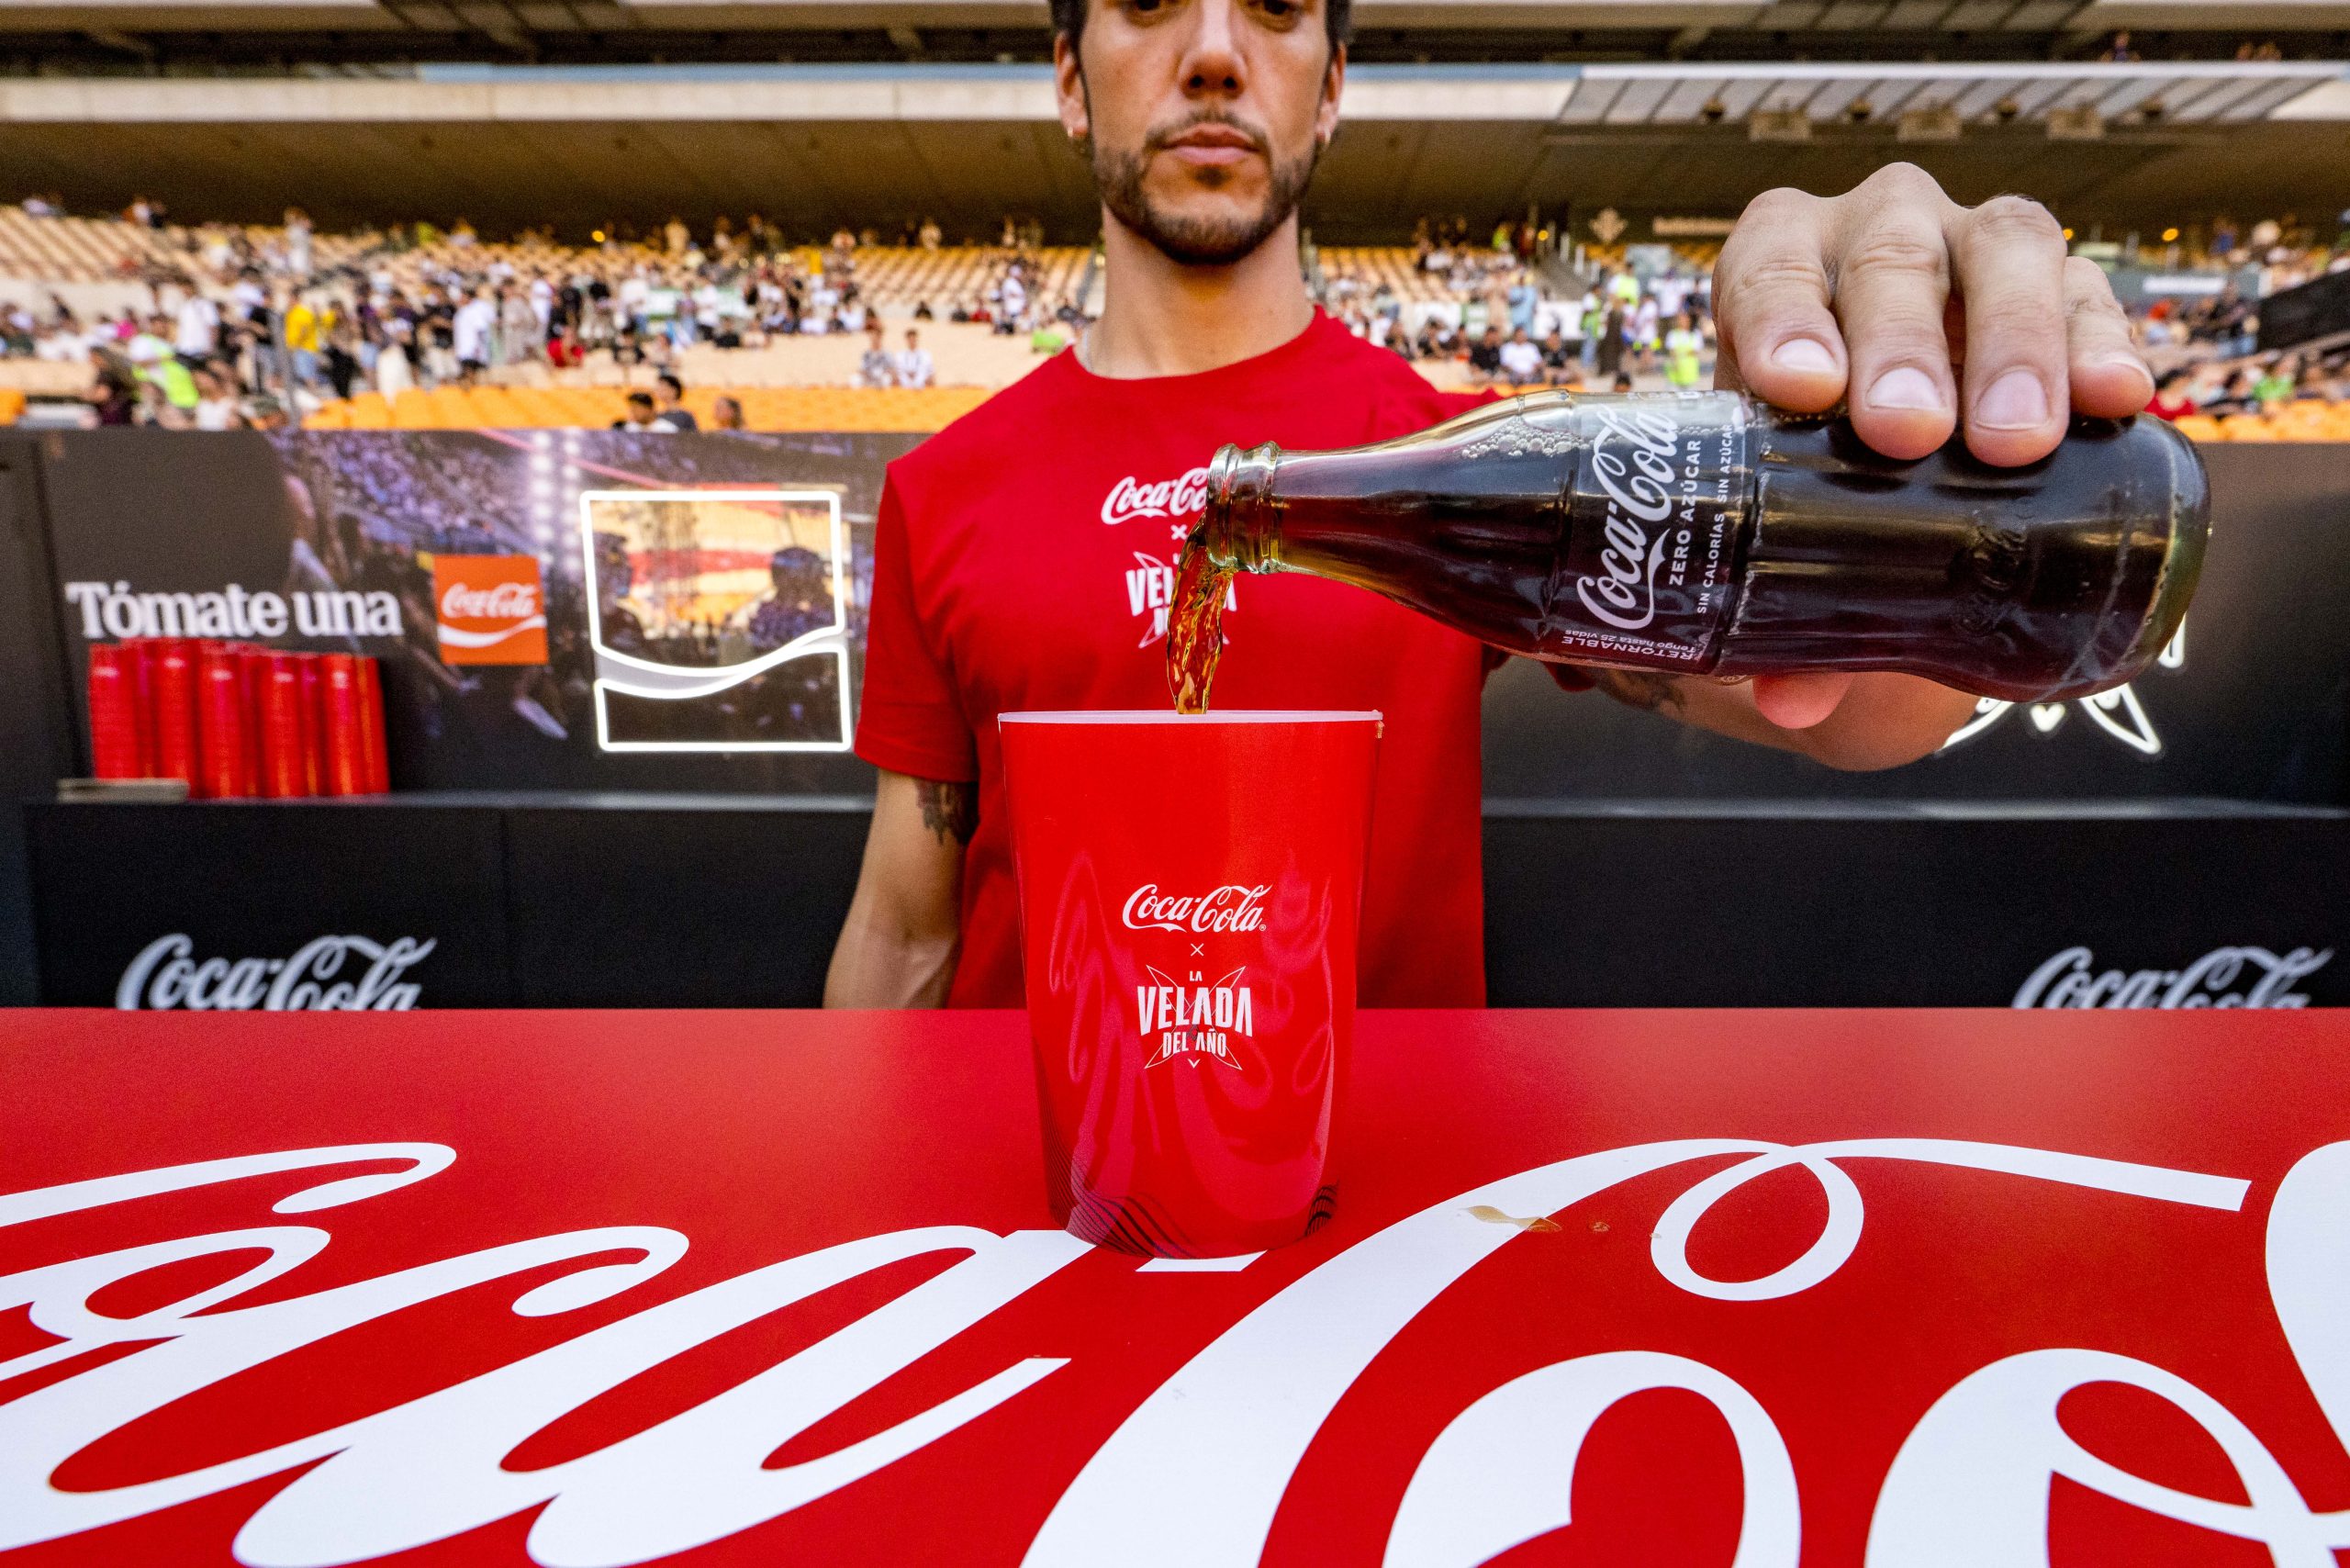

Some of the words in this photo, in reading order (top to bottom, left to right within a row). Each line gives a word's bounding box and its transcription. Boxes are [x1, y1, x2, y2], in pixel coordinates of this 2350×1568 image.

[1719, 424, 1733, 475] AZÚCAR
[1101, 467, 1208, 525] Coca-Co
[1679, 440, 1702, 522] AZÚCAR
[1718, 479, 1729, 503] SIN
[1577, 403, 1678, 629] Coca-Cola
[1669, 530, 1691, 586] ZERO
[1703, 513, 1725, 588] CALORÍAS
[64, 580, 289, 639] Tómate
[290, 590, 404, 637] una
[1696, 592, 1710, 614] SIN
[1561, 635, 1695, 661] RETORNABLE
[1565, 629, 1597, 639] vidas
[1619, 636, 1655, 647] hasta
[1189, 970, 1203, 982] LA
[1136, 985, 1253, 1037] VELADA
[1162, 1031, 1189, 1058] DEL
[1195, 1028, 1226, 1058] AÑO
